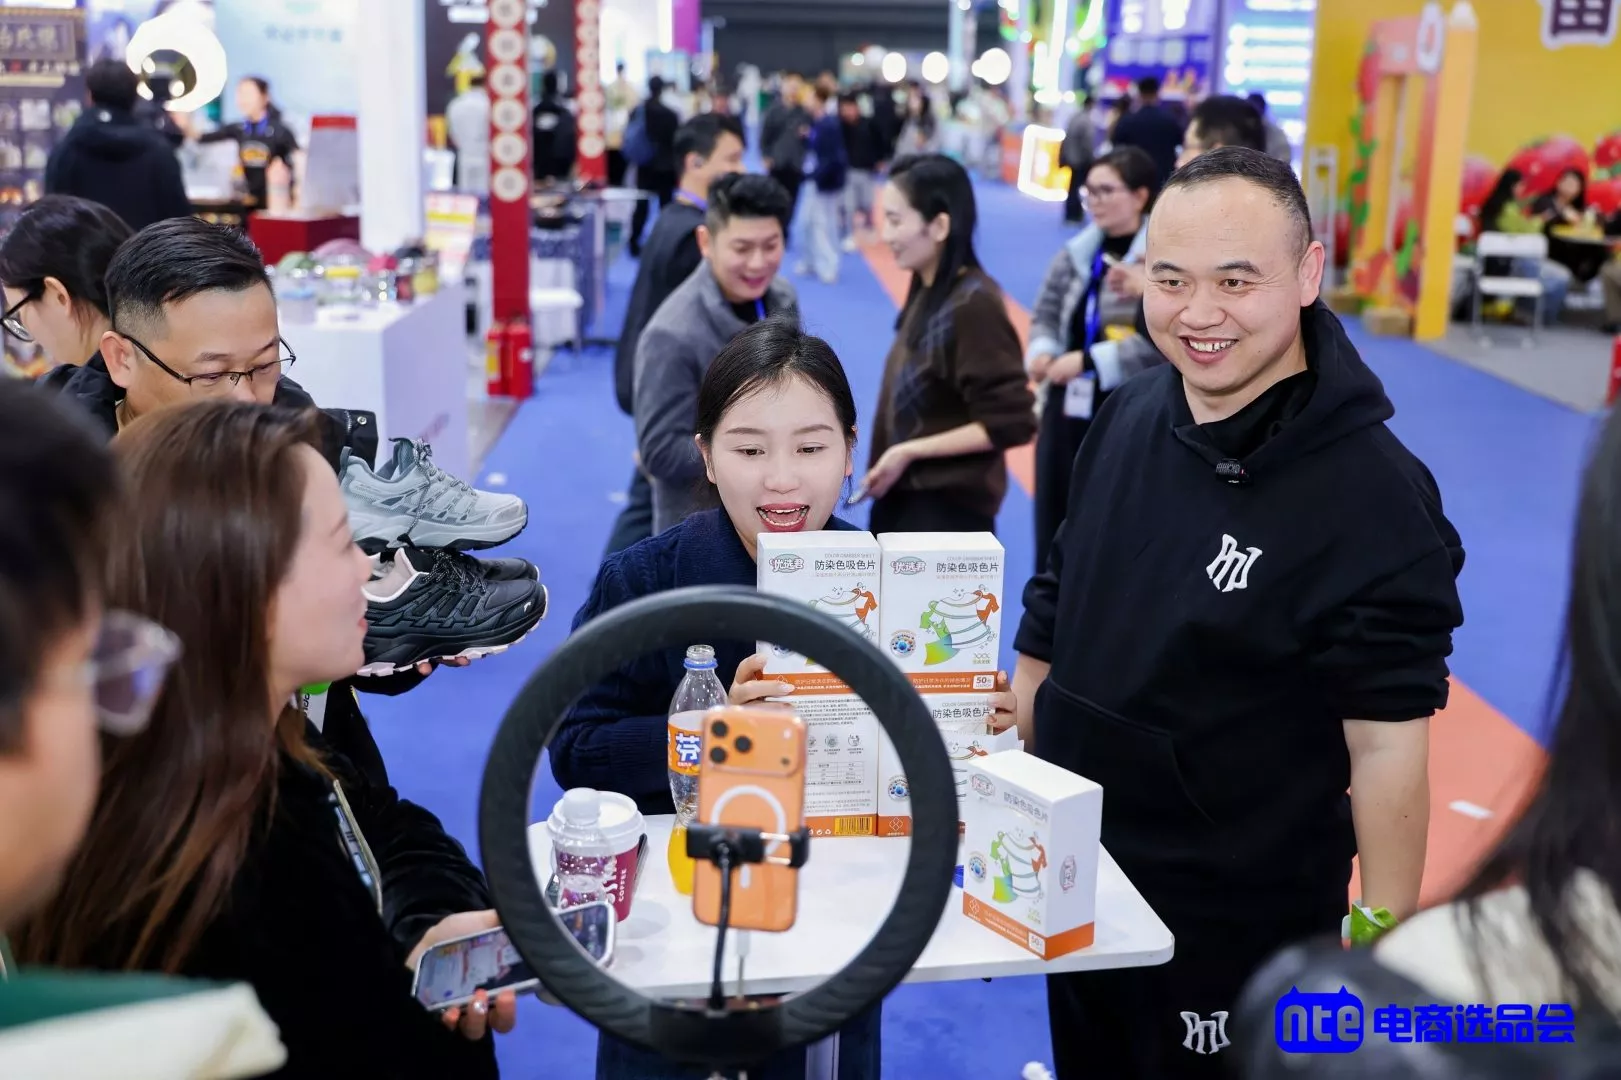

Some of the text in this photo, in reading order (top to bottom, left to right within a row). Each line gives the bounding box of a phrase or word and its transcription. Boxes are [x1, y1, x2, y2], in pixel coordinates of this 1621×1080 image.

[814, 560, 876, 571] 防染色吸色片
[936, 562, 999, 573] 防染色吸色片
[932, 708, 991, 719] 防染色吸色片
[618, 868, 628, 903] COFFEE
